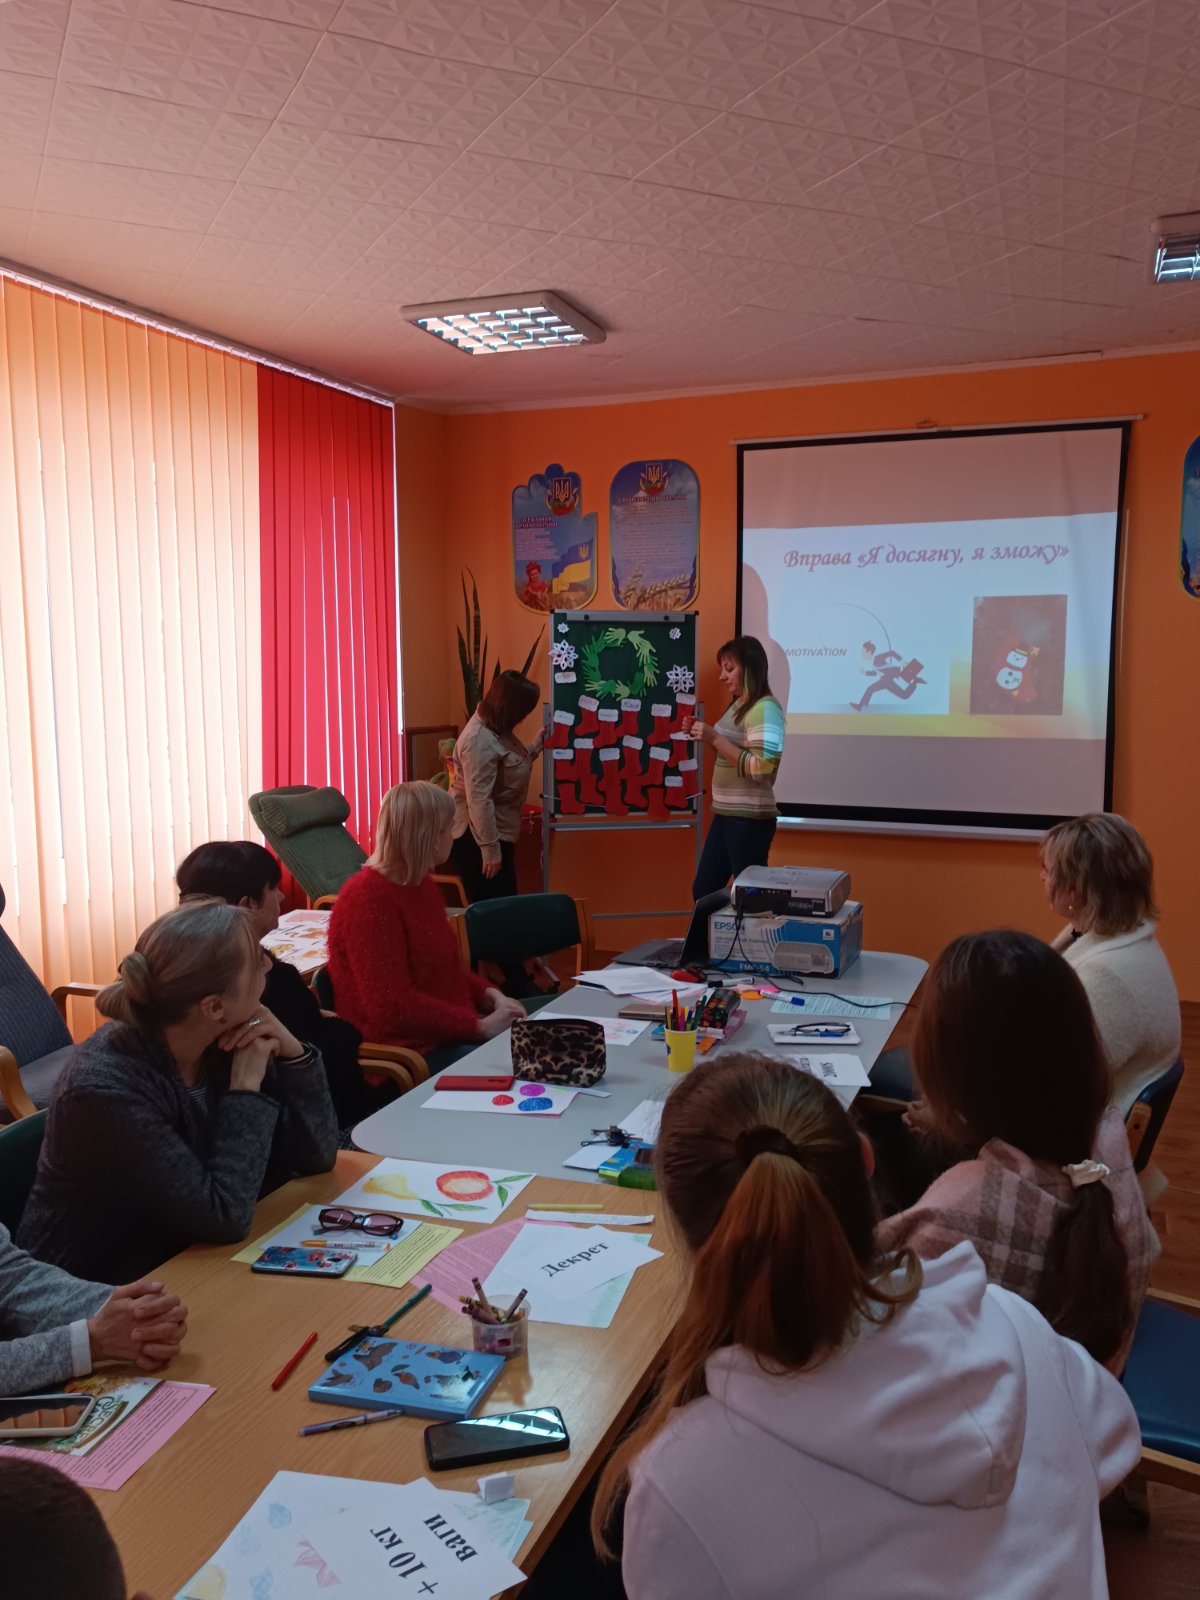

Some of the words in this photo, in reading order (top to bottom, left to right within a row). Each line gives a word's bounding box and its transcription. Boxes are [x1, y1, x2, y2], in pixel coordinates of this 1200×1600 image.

[784, 550, 852, 573] Вправа
[857, 545, 884, 567] «Я
[885, 543, 964, 568] досягну,
[971, 548, 986, 561] я
[990, 542, 1070, 567] зможу»
[785, 648, 847, 657] MOTIVATION
[714, 921, 745, 931] EPSON
[540, 1242, 609, 1277] Декрет
[369, 1526, 403, 1550] кг
[423, 1513, 478, 1562] ваги
[388, 1551, 428, 1579] 10
